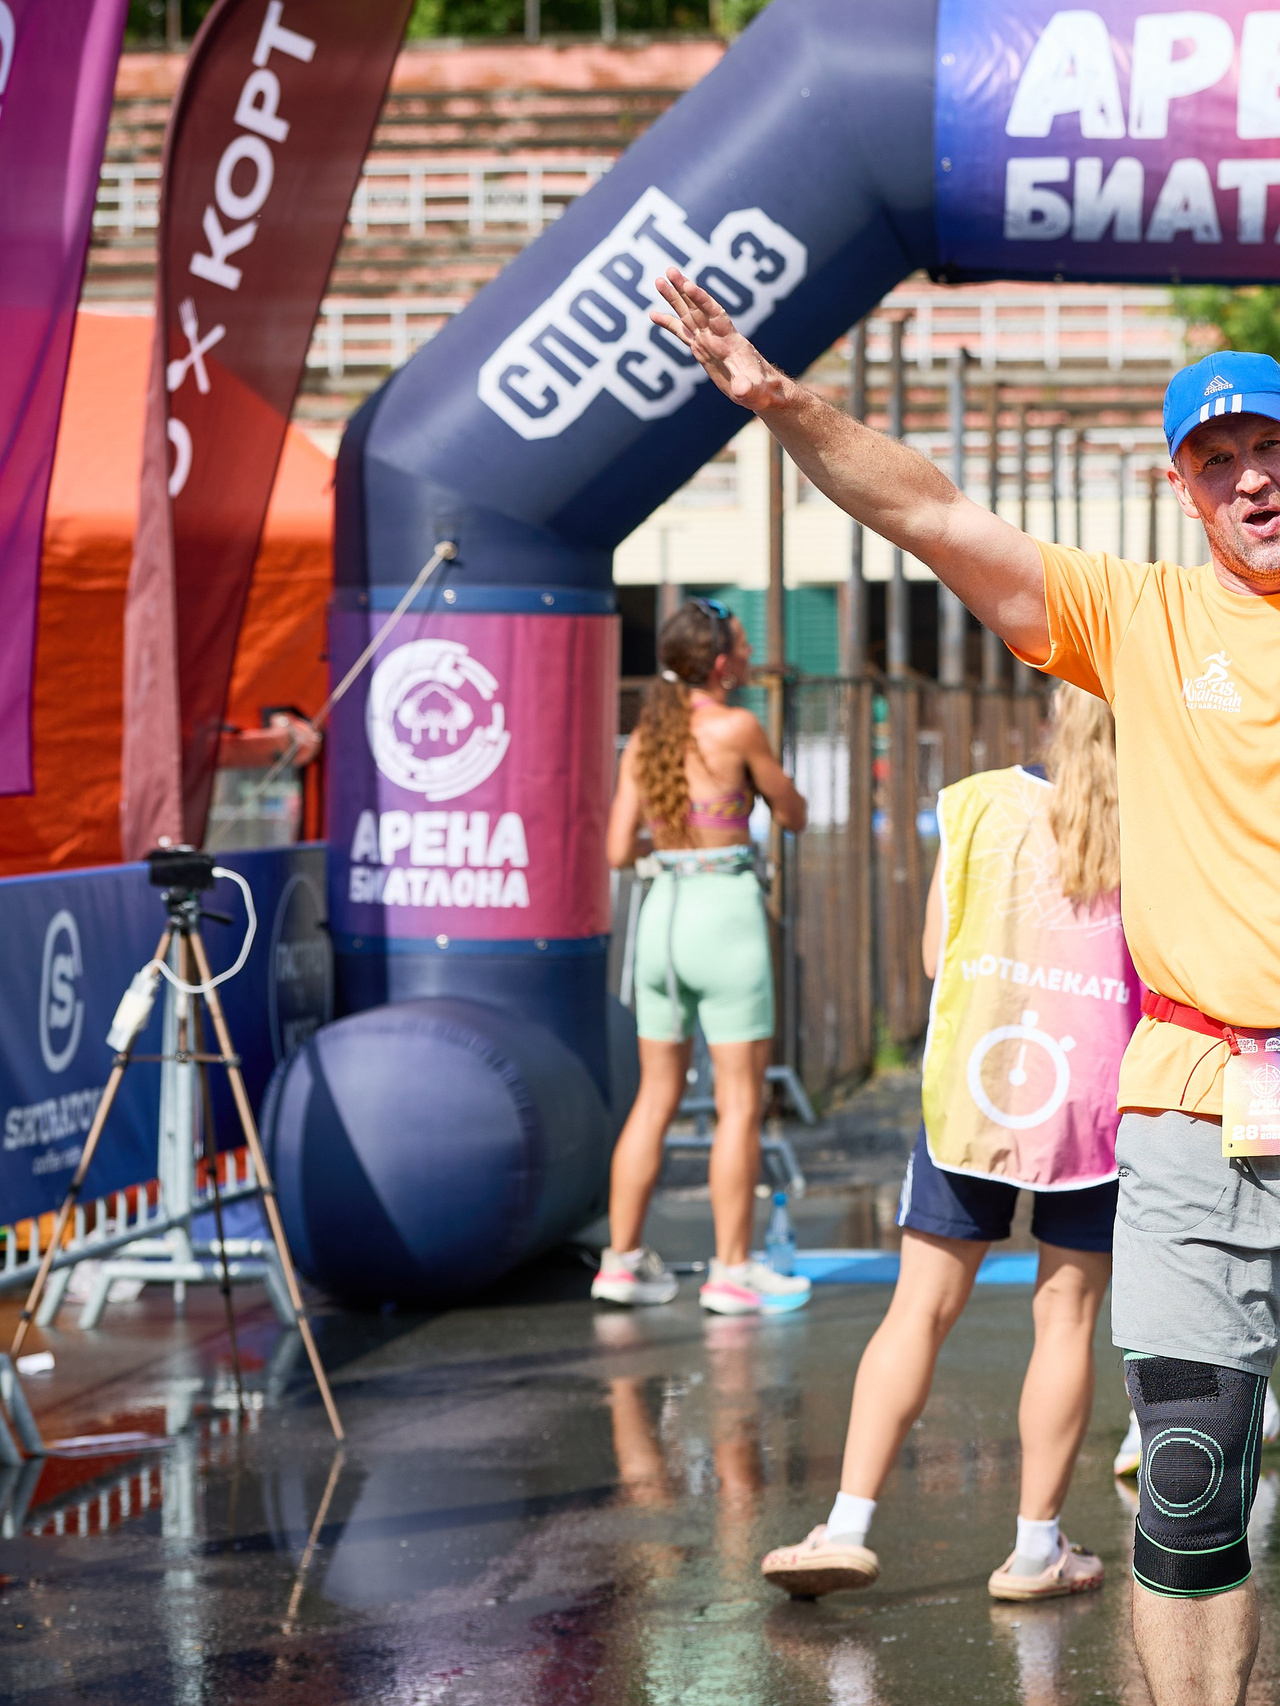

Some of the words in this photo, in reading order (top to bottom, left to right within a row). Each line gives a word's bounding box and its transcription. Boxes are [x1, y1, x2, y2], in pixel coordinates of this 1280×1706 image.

[189, 0, 317, 290] КОРТ
[499, 214, 692, 420] СПОРТ
[1204, 383, 1234, 397] adidas
[350, 808, 530, 869] АРЕНА
[349, 866, 531, 909] БИАТЛОНА
[1232, 1124, 1259, 1141] 28
